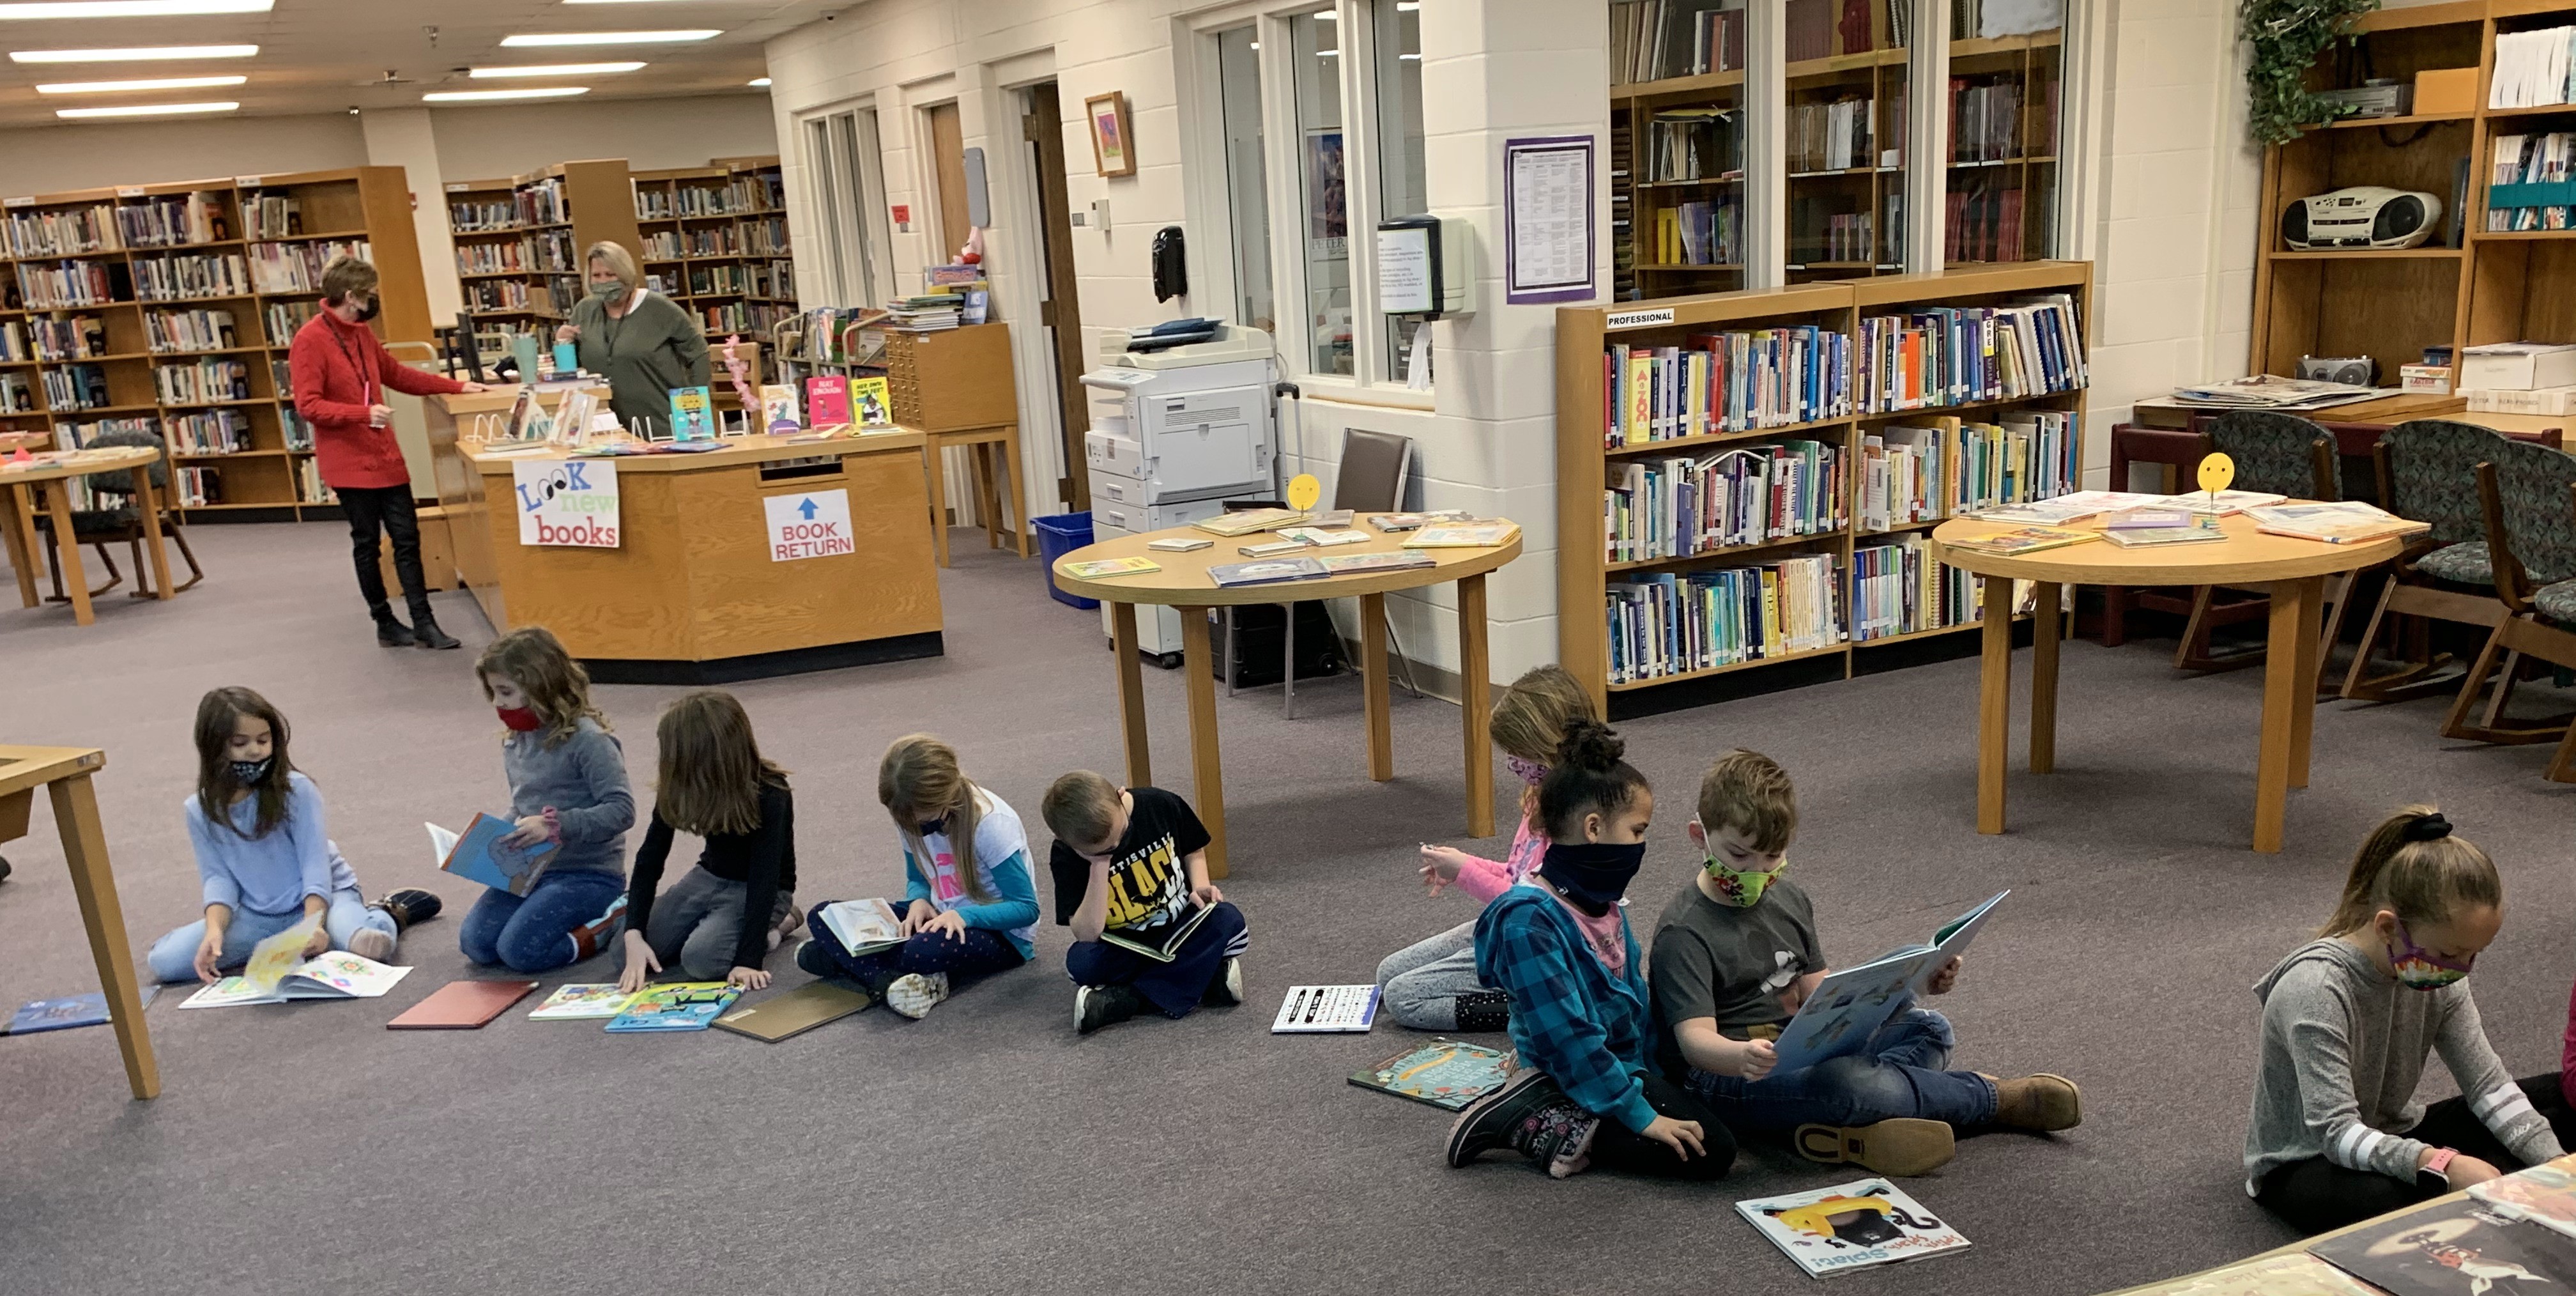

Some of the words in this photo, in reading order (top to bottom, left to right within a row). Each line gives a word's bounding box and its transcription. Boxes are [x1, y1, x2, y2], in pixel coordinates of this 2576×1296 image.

[1312, 237, 1345, 250] PETER
[1608, 312, 1673, 325] PROFESSIONAL
[813, 387, 841, 396] ENOUGH
[559, 493, 618, 513] new
[534, 514, 617, 546] books
[782, 522, 838, 541] BOOK
[776, 537, 852, 559] RETURN
[1882, 1233, 1929, 1251] Splash,
[1918, 1234, 1963, 1249] Splish,
[1811, 1248, 1889, 1268] Splat!
